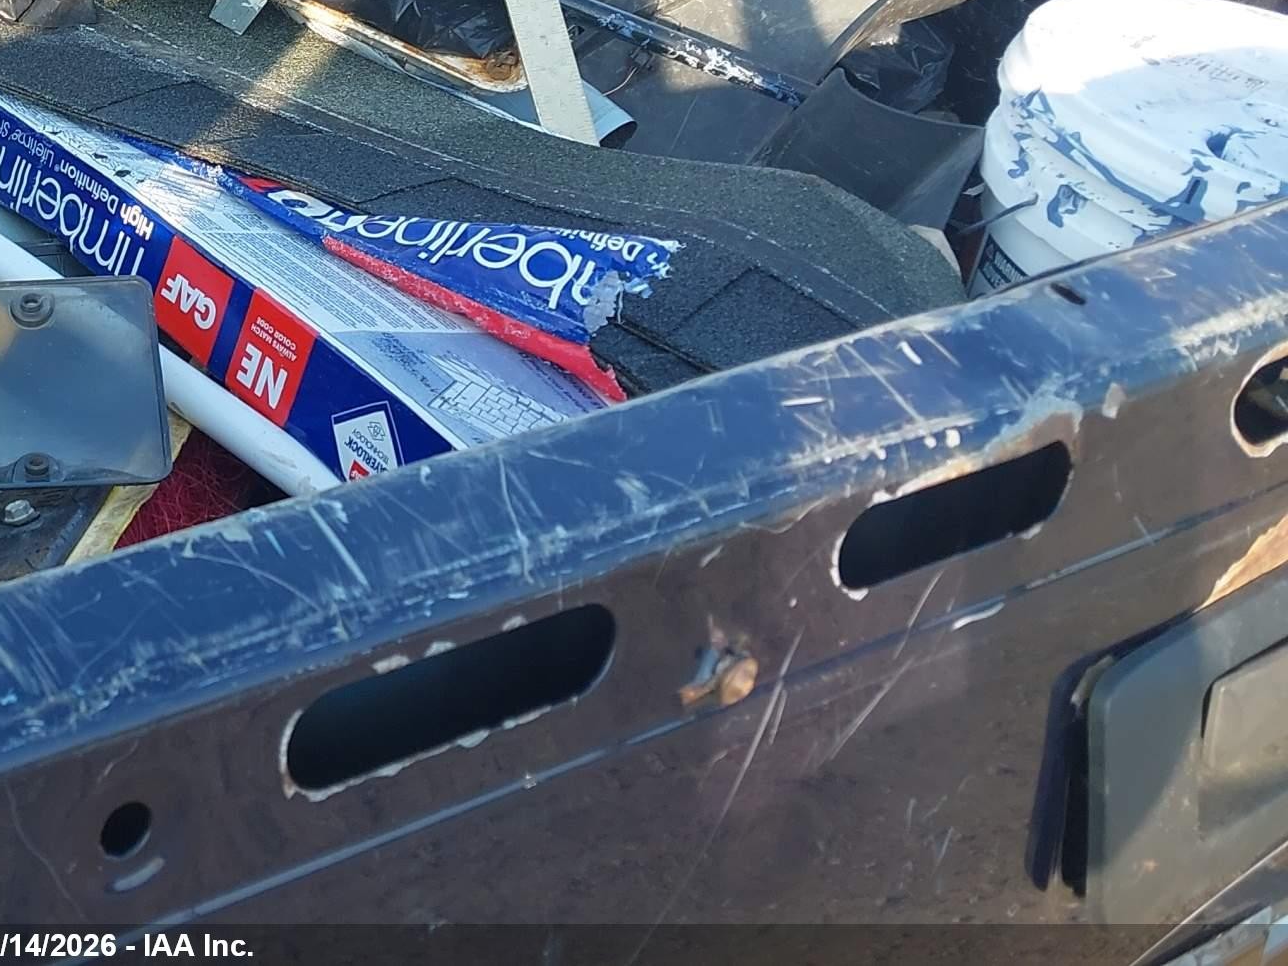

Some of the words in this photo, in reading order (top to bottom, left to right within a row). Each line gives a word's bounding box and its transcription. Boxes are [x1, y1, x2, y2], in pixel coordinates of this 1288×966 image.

[120, 202, 155, 241] High
[160, 273, 217, 331] GAF
[250, 322, 273, 345] MATCH
[256, 316, 274, 335] CODE
[273, 330, 297, 351] COLOR
[271, 339, 298, 362] ALWAYS
[236, 342, 288, 410] NE
[344, 435, 389, 475] AYERLOCK
[352, 428, 390, 466] TECHNOLOGY
